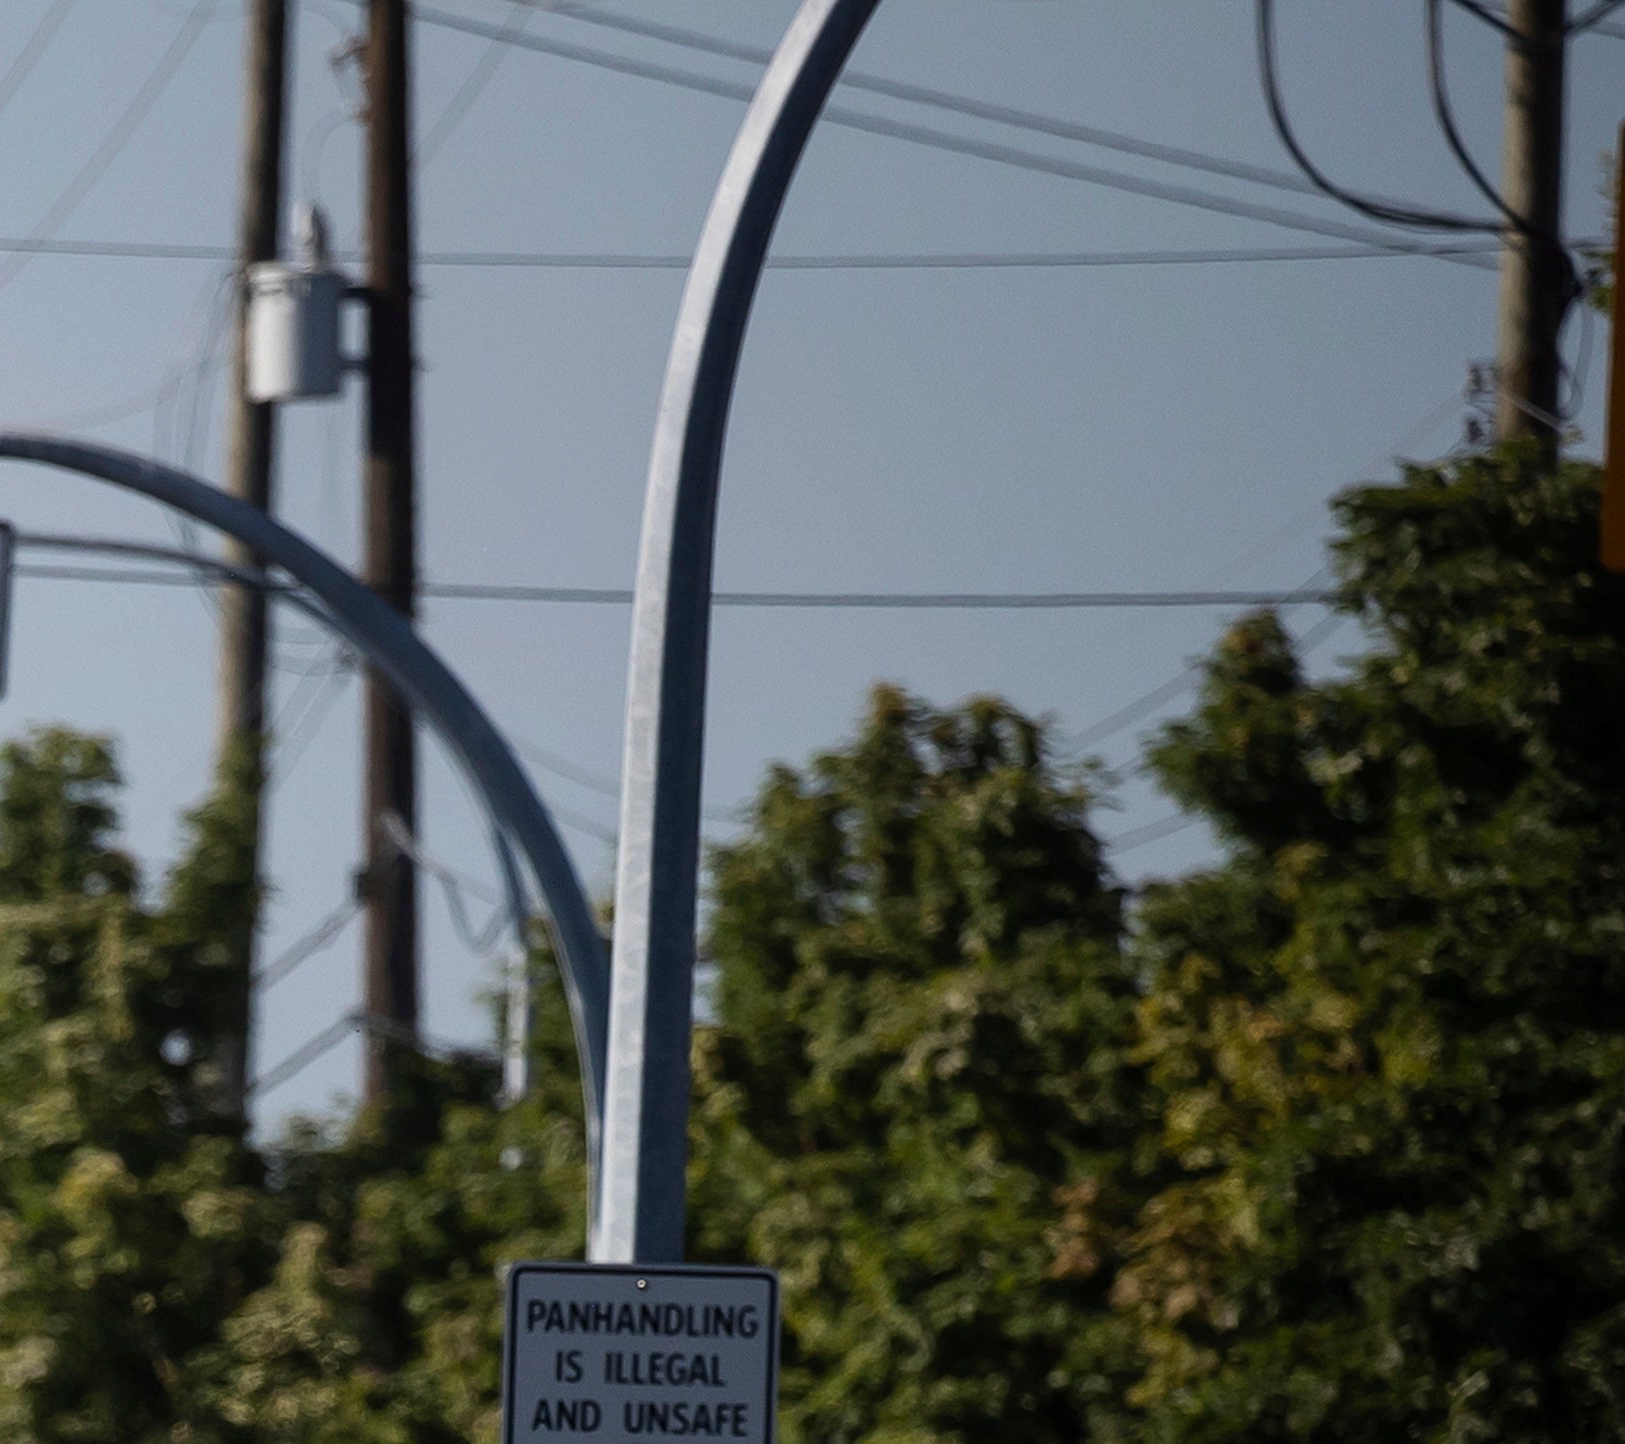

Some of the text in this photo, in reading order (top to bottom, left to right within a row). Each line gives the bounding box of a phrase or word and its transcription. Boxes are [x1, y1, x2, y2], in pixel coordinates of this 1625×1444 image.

[528, 1300, 759, 1338] PANHANDLING
[556, 1352, 726, 1387] IS ILLEGAL
[532, 1400, 749, 1436] AND UNSAFE
